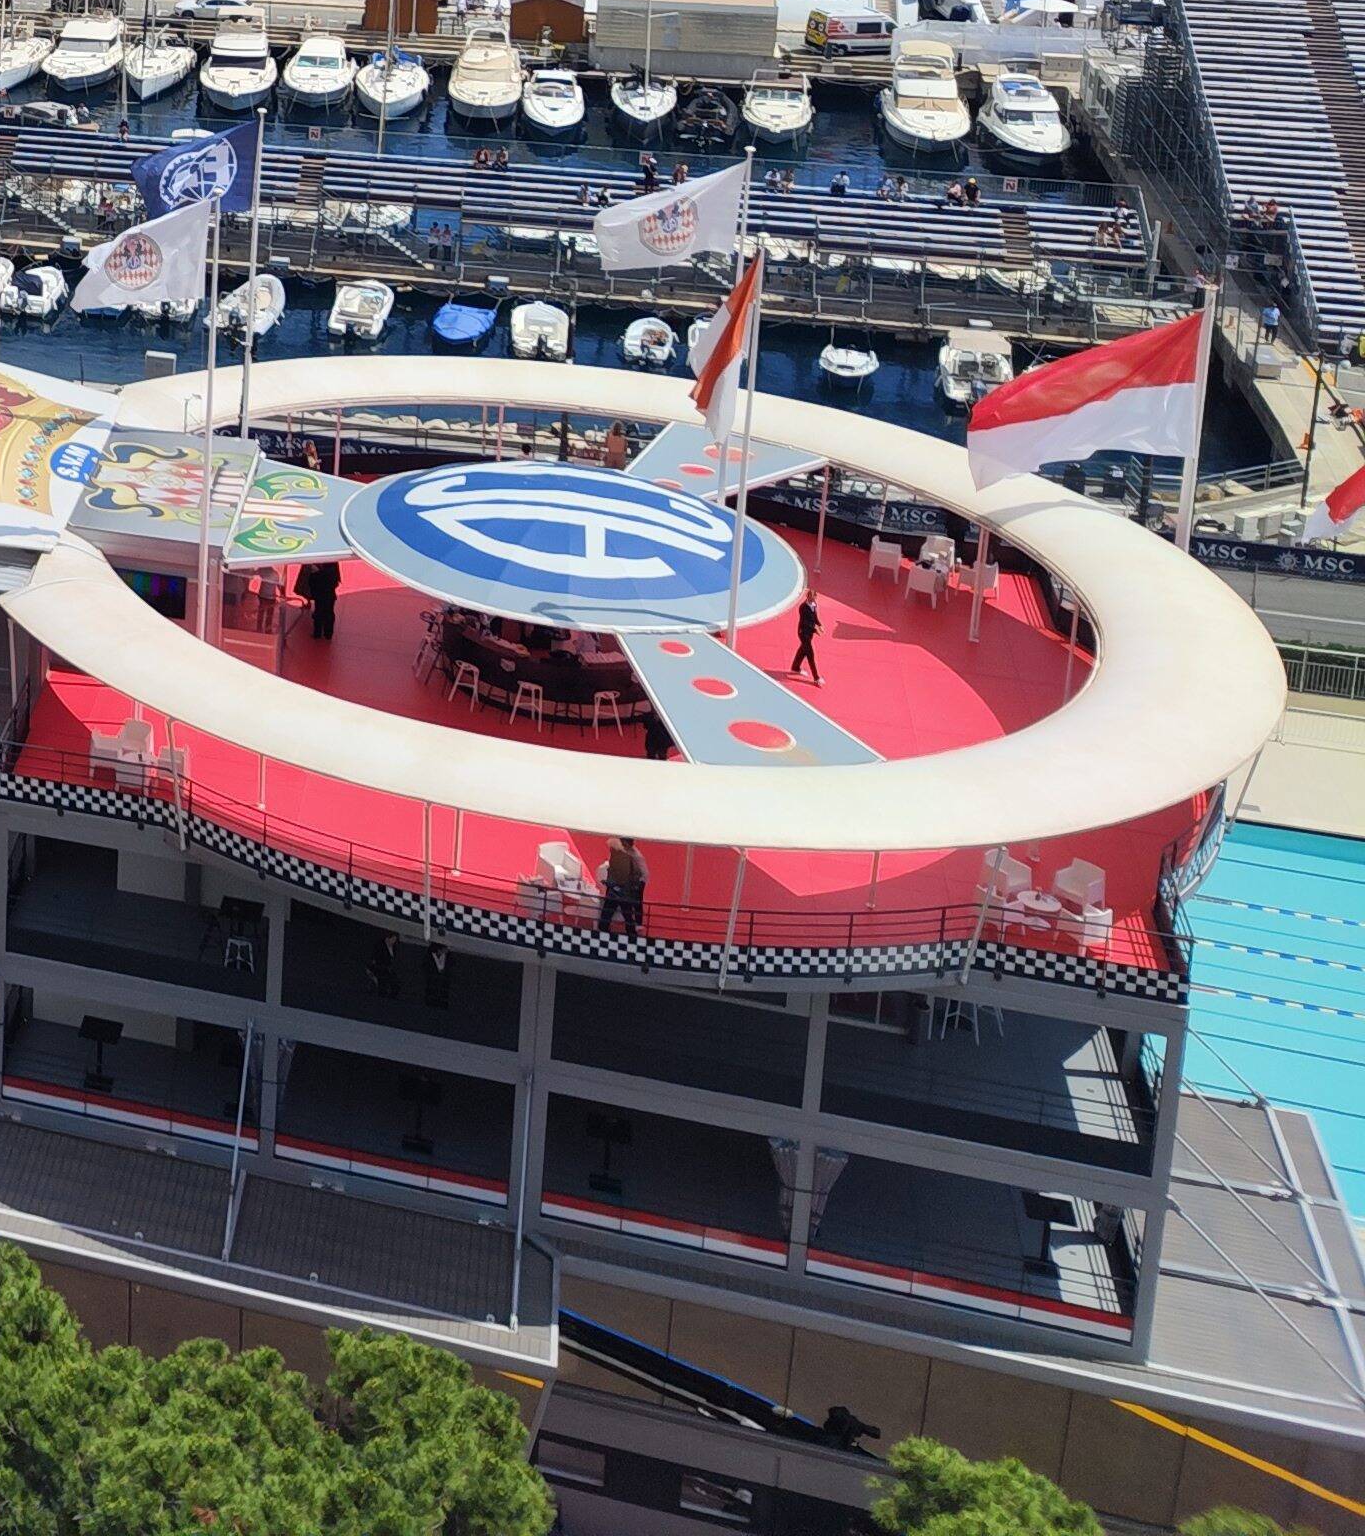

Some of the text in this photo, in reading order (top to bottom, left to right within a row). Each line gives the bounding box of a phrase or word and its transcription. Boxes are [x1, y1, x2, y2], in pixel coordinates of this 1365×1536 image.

[794, 497, 839, 514] MSC
[890, 506, 937, 526] MSC
[1197, 541, 1247, 561] MSC
[1304, 554, 1355, 574] MSC
